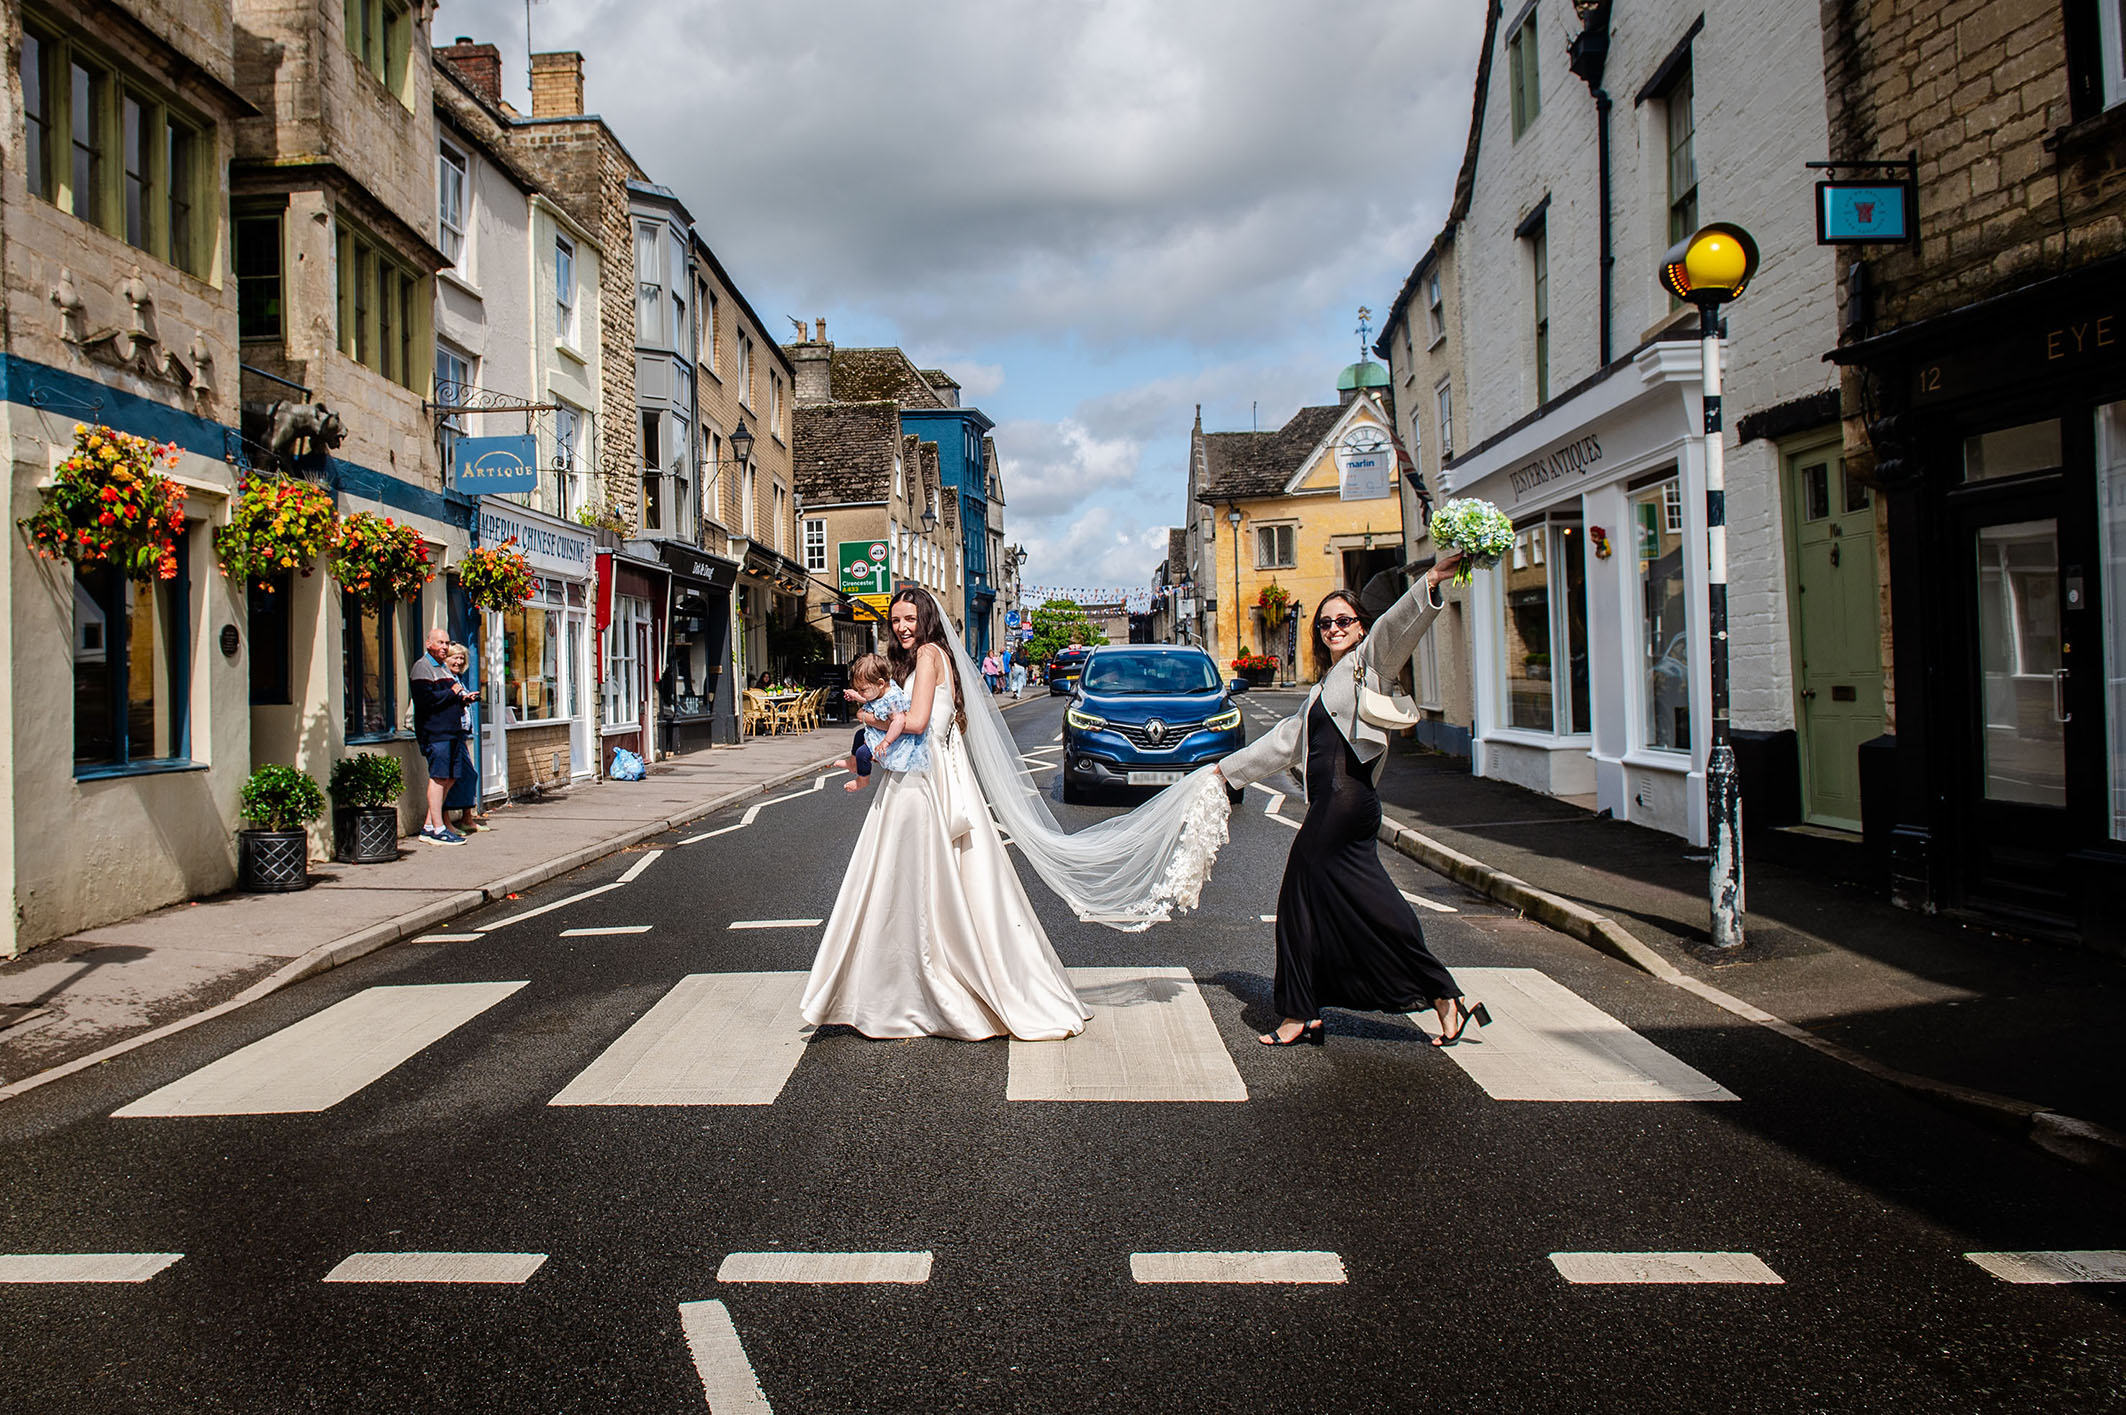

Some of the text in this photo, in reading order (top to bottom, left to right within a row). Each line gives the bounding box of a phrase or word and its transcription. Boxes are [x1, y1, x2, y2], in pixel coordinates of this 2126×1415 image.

[2047, 315, 2116, 360] EYE
[1919, 366, 1941, 393] 12
[1345, 458, 1376, 469] marlin
[1508, 433, 1603, 503] JESTERS ANTIQUES
[480, 512, 520, 547] MPERIAL
[521, 525, 556, 557] CHINESE
[556, 535, 585, 563] CUISINE
